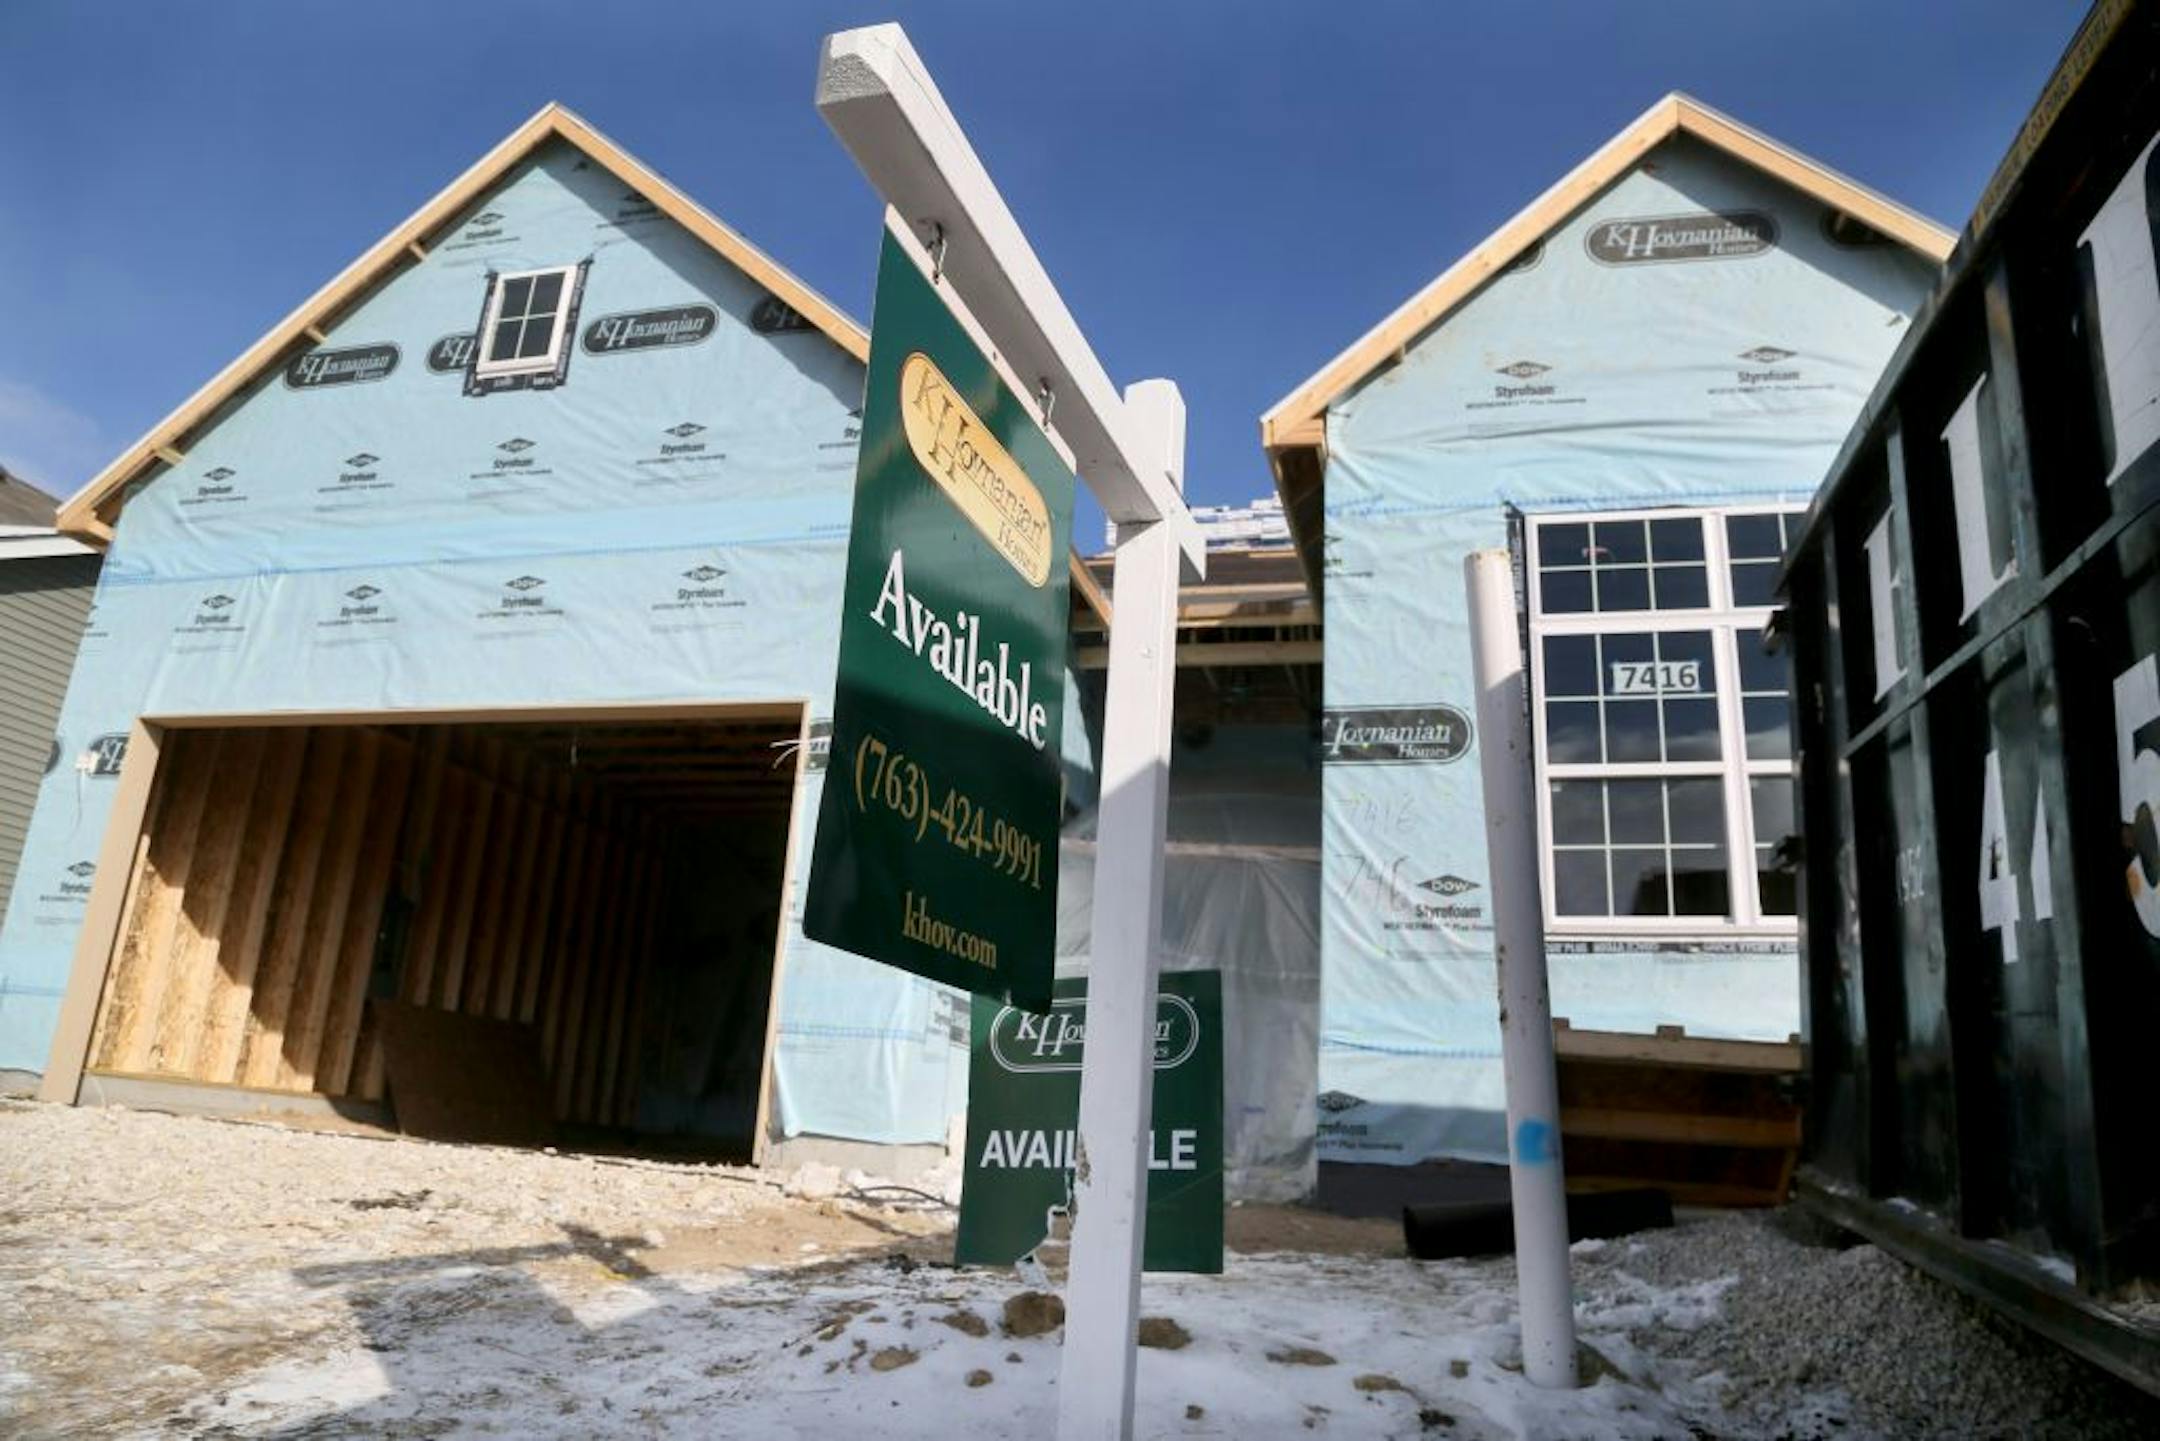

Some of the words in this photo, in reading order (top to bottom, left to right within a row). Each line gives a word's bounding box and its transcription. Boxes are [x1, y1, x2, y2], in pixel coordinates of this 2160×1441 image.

[870, 548, 1047, 751] Available
[1620, 664, 1696, 689] 7416
[855, 733, 1042, 889] (763)-424-9991
[903, 892, 997, 969] khov.com
[1416, 903, 1481, 920] Styrofoam
[979, 1129, 1197, 1171] AVAILLE
